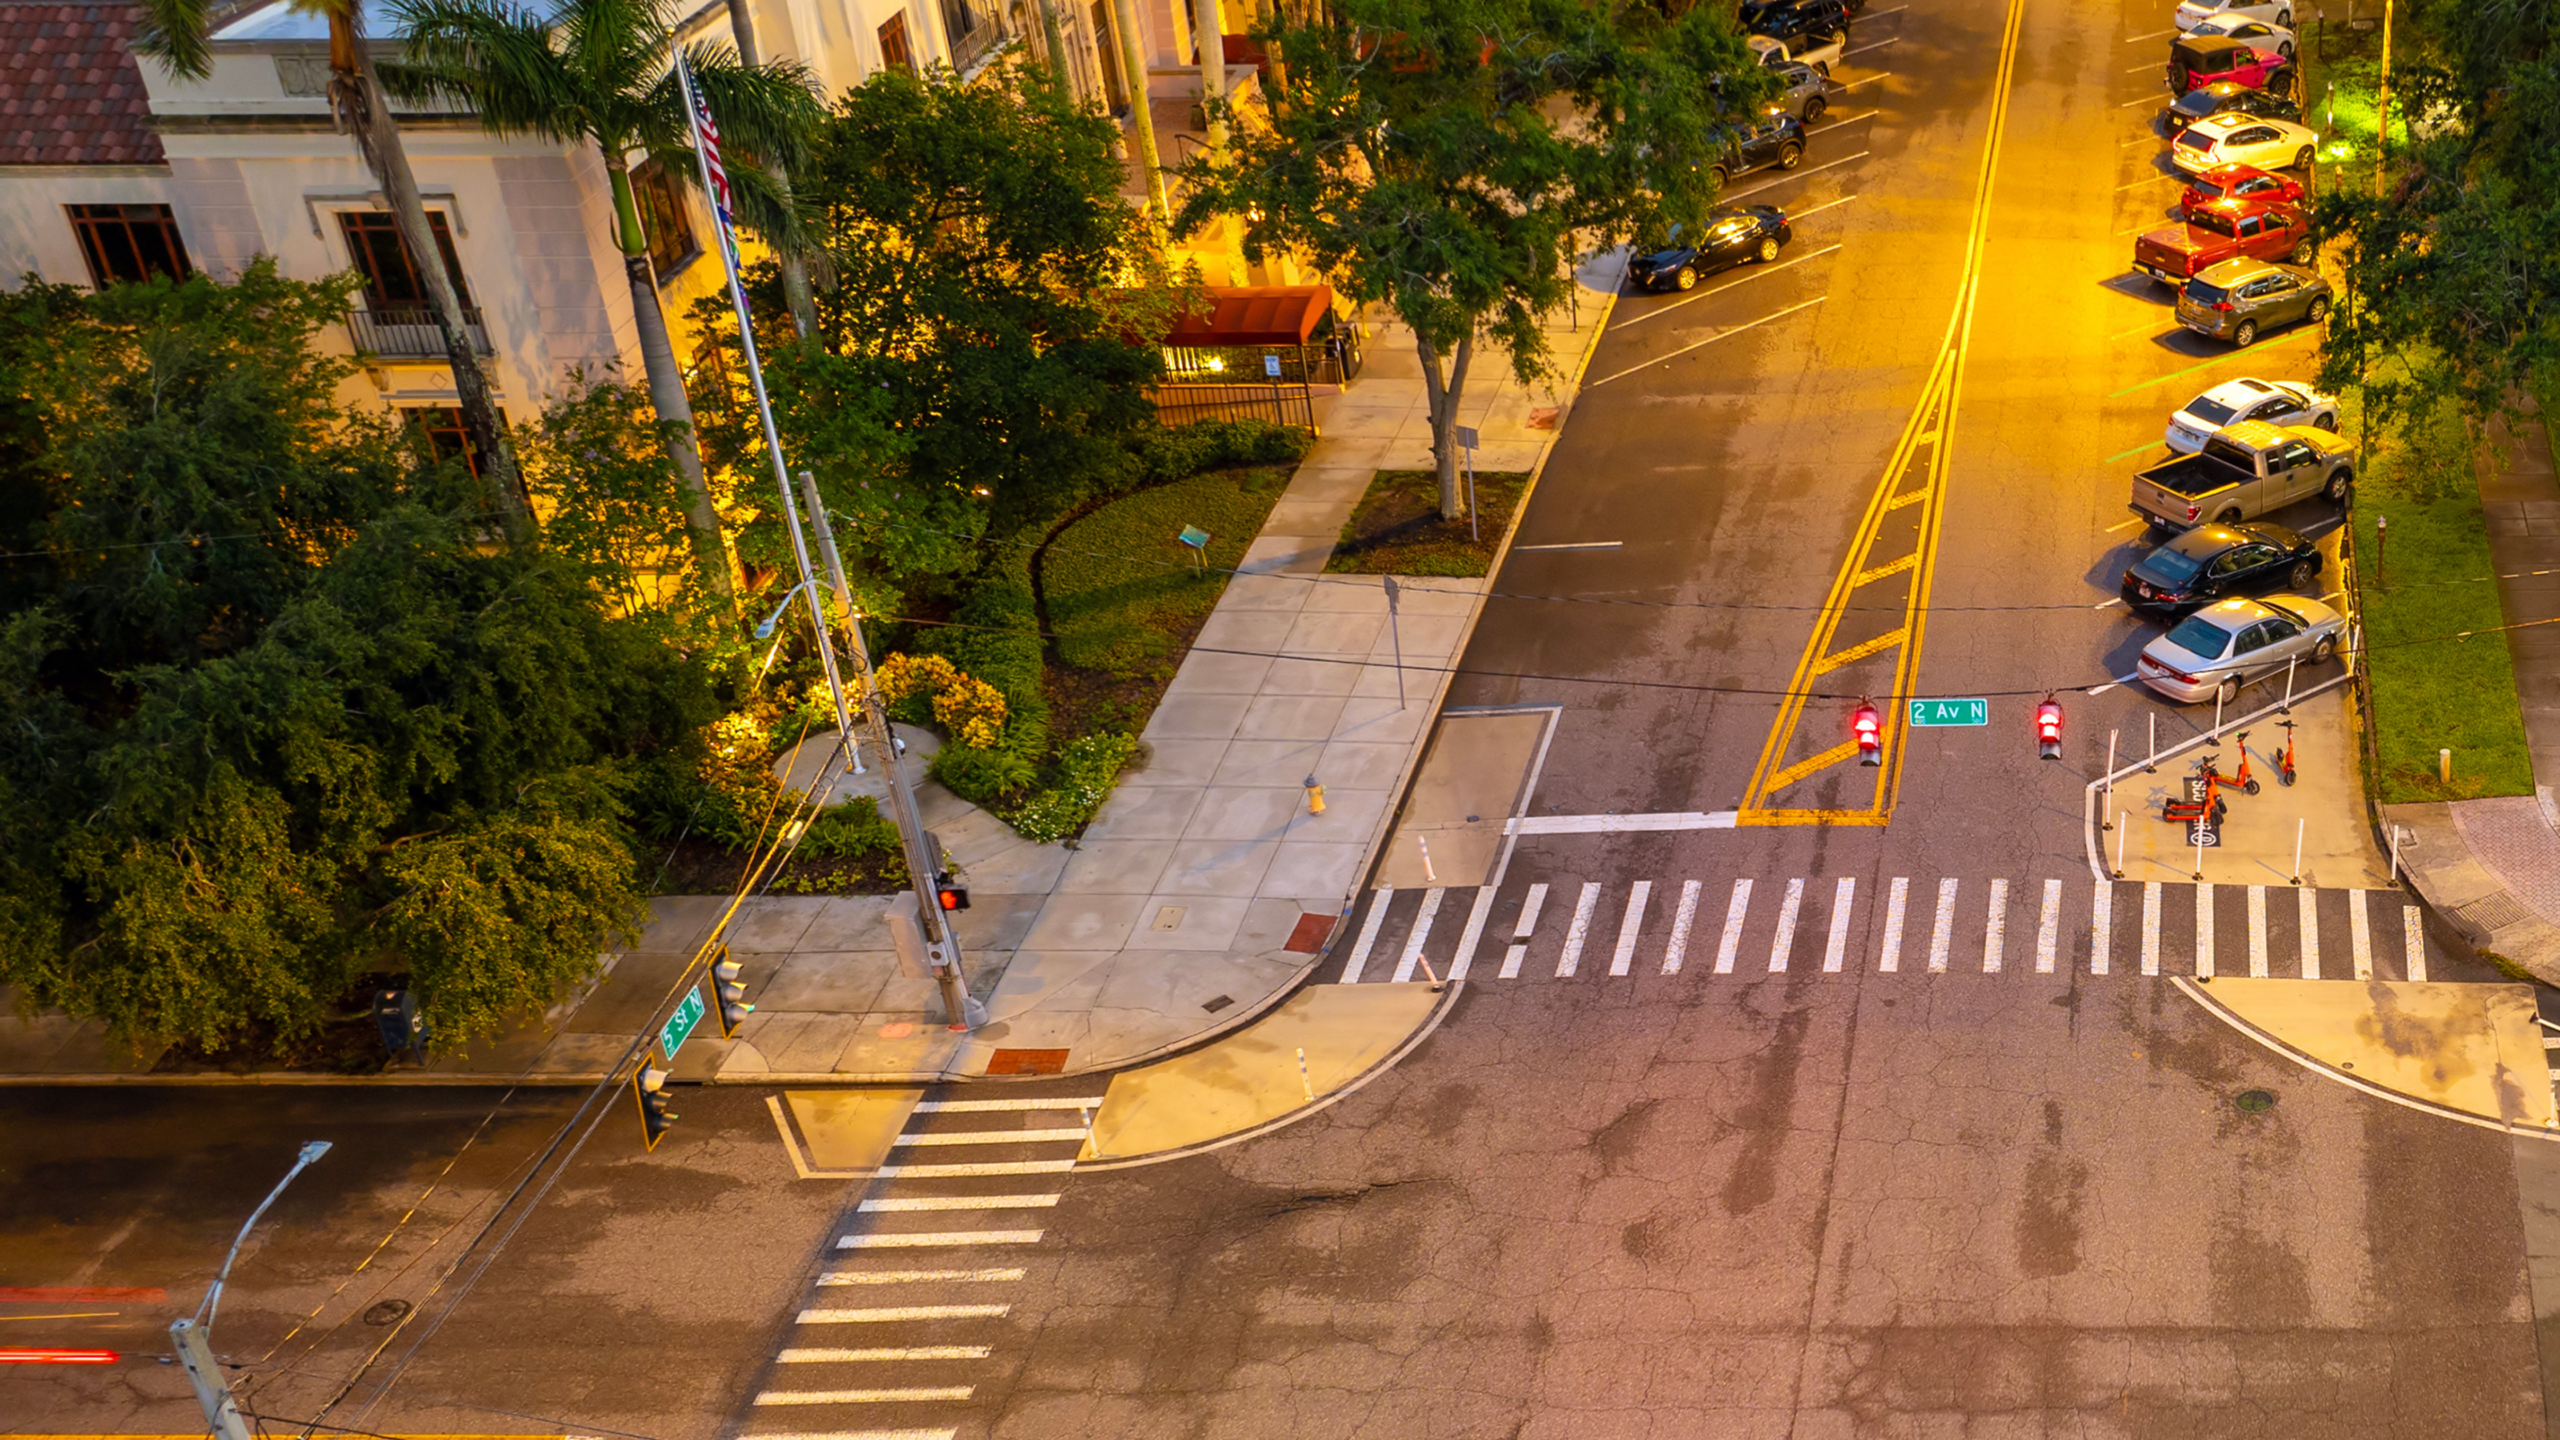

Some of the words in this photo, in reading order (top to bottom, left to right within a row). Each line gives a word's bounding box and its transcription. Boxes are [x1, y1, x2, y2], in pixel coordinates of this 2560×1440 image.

[1913, 703, 1925, 718] 2
[1936, 703, 1960, 718] Av
[1971, 702, 1982, 718] N
[663, 1027, 673, 1048] 5
[675, 1007, 689, 1031] St
[690, 990, 702, 1012] N
